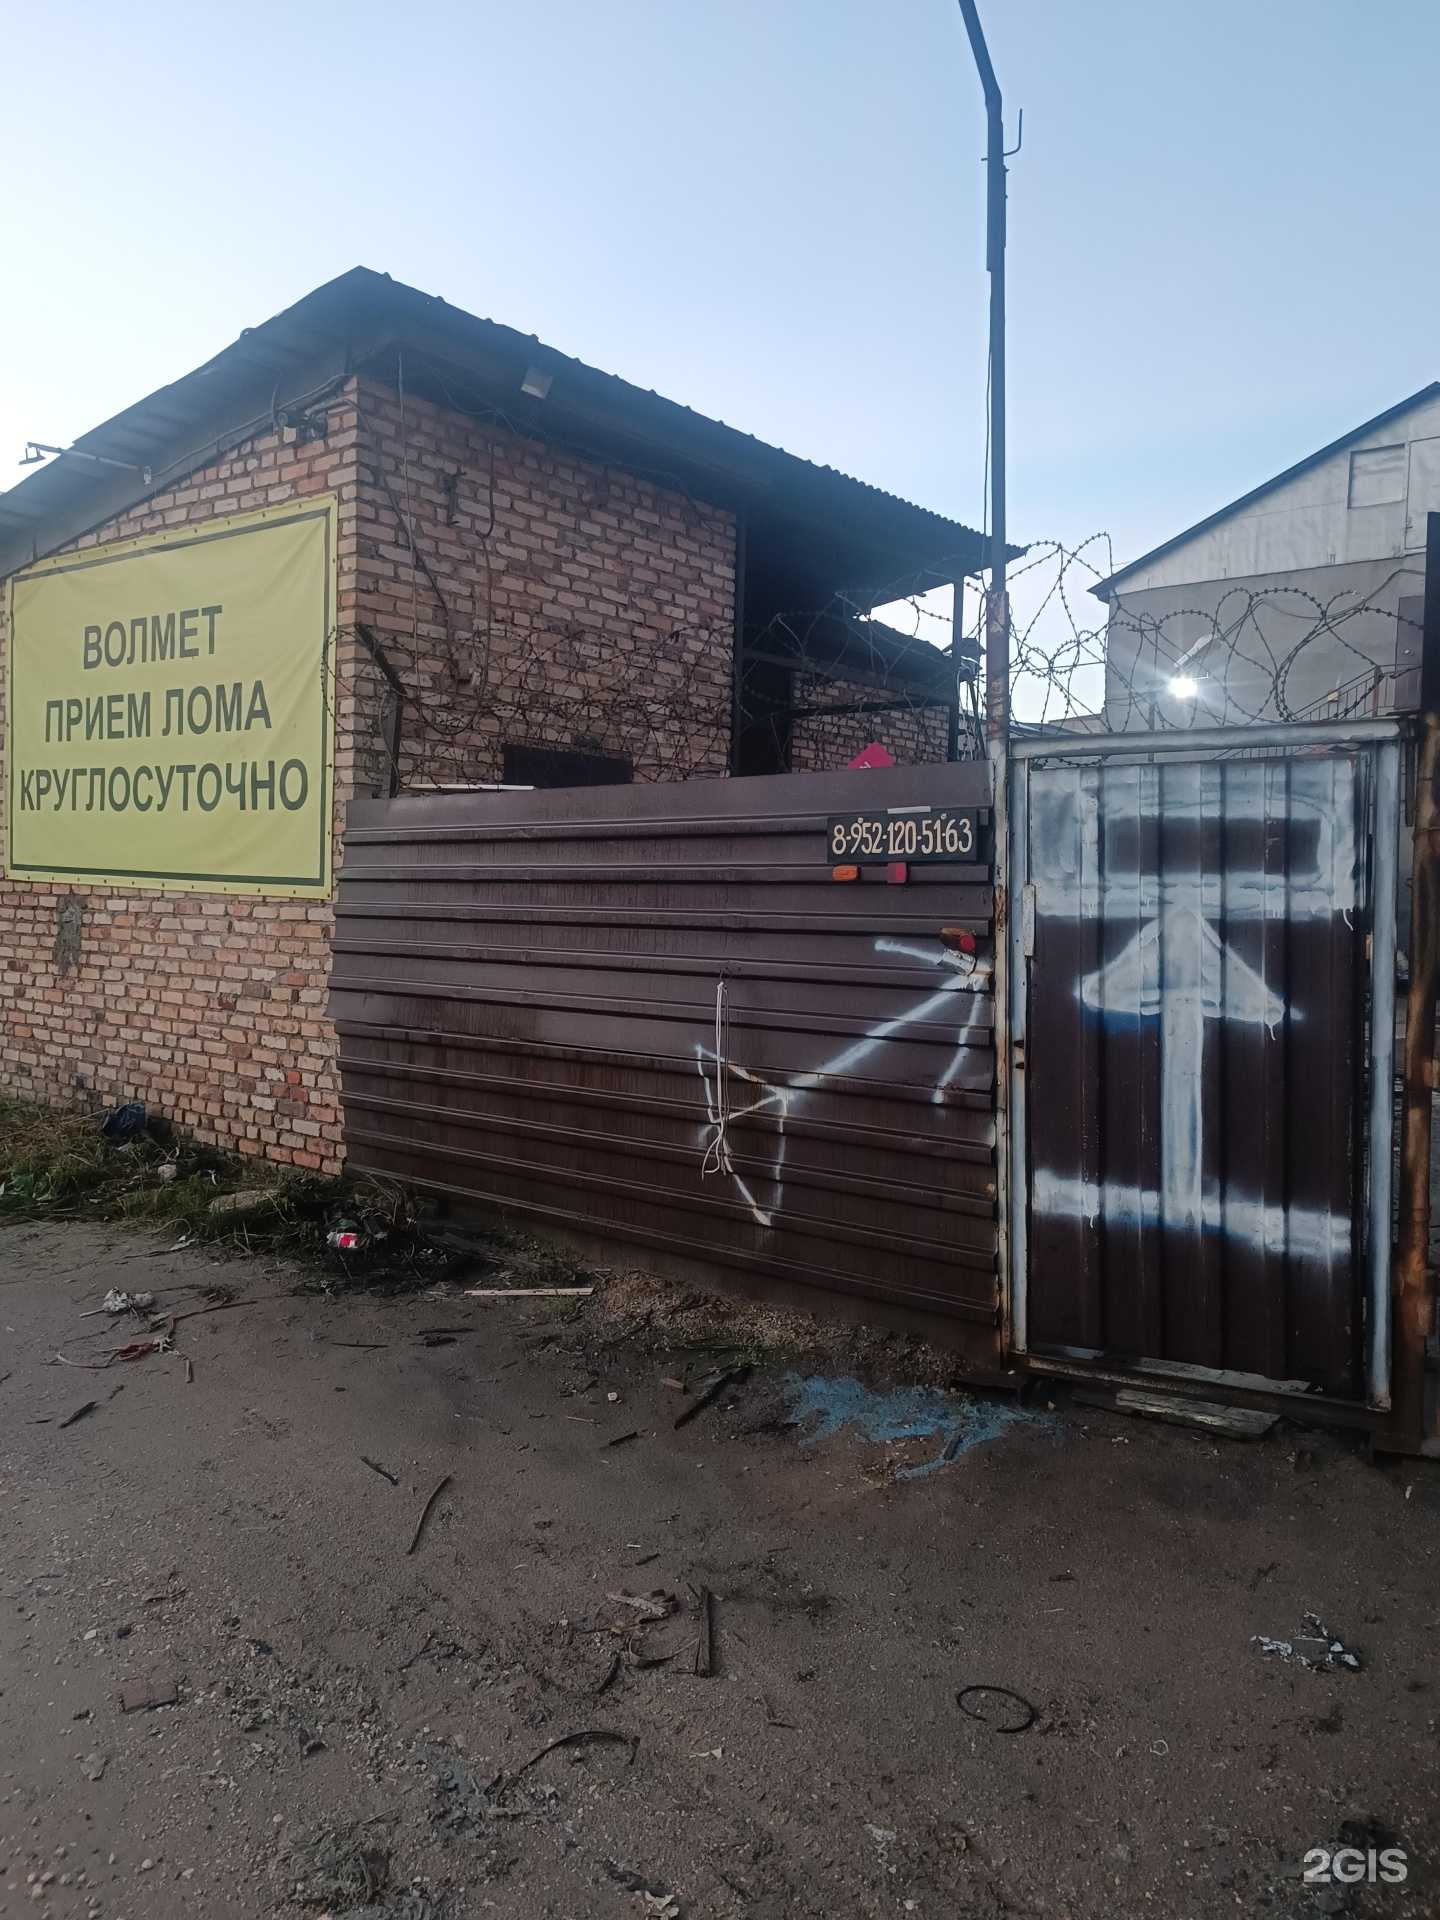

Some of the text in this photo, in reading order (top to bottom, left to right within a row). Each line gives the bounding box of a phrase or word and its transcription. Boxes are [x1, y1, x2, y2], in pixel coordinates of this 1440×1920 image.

[83, 605, 223, 669] ВОЛМЕТ
[45, 680, 272, 743] ПРИЕМ ЛОМА
[20, 758, 308, 812] КРУГЛОСУТОЧНО
[832, 818, 973, 855] 8-952-120-51-63
